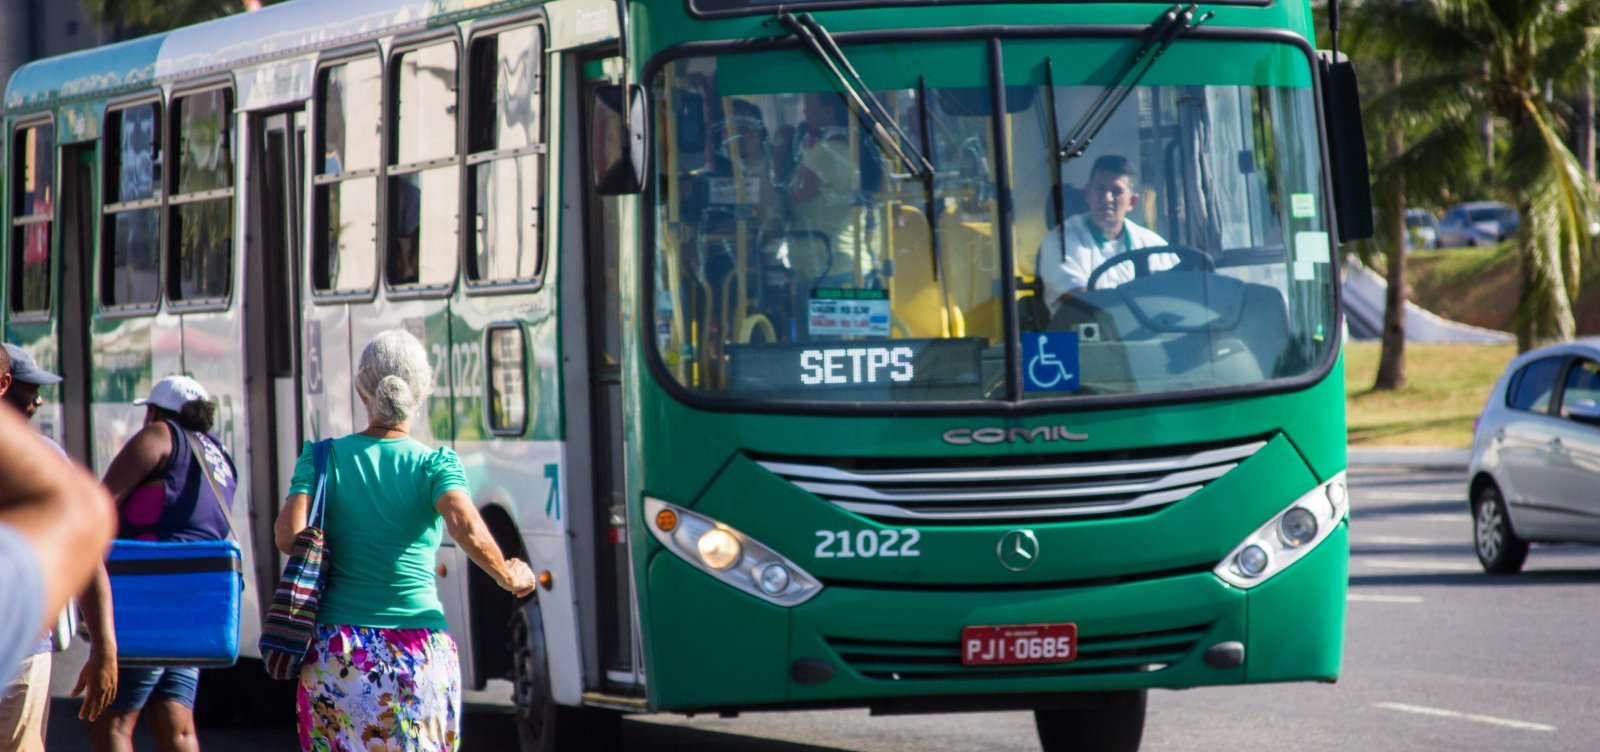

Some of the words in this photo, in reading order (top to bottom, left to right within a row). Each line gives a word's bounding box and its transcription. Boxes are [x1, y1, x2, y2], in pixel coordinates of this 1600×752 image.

[431, 342, 482, 398] 21022
[800, 347, 914, 384] SETPS
[943, 425, 1089, 445] COMIL
[815, 528, 920, 558] 21022
